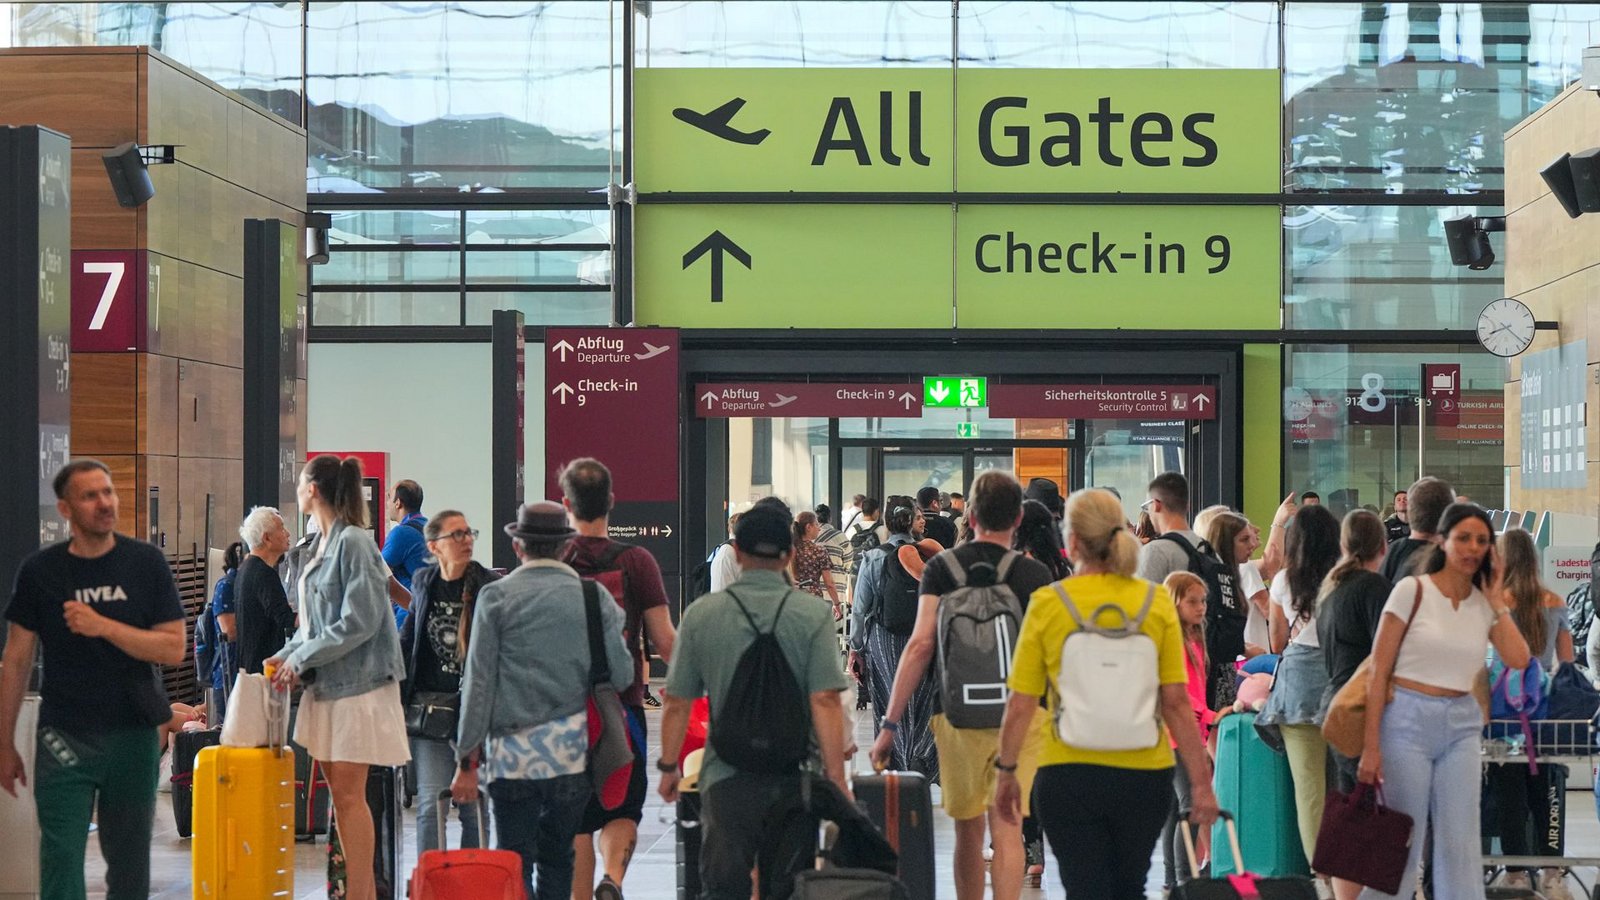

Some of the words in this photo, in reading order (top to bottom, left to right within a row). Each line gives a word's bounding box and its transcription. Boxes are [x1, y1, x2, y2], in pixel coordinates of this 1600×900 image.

[811, 91, 931, 166] All
[978, 96, 1218, 167] Gates
[975, 231, 1185, 273] Check-in
[1204, 235, 1231, 274] 9
[83, 262, 125, 330] 7
[577, 336, 624, 352] Abflug
[578, 353, 631, 364] Departure
[578, 379, 638, 391] Check-in
[721, 388, 759, 401] Abflug
[836, 389, 885, 400] Check-in
[887, 389, 895, 400] 9
[1045, 390, 1157, 401] Sicherheitskontrolle
[1160, 391, 1167, 401] 5
[1361, 372, 1386, 412] 8
[578, 394, 586, 406] 9
[722, 402, 765, 411] Departure
[1098, 402, 1133, 413] Security
[1135, 402, 1168, 412] Control
[1547, 786, 1560, 828] JORDAN
[1548, 829, 1559, 850] AIR
